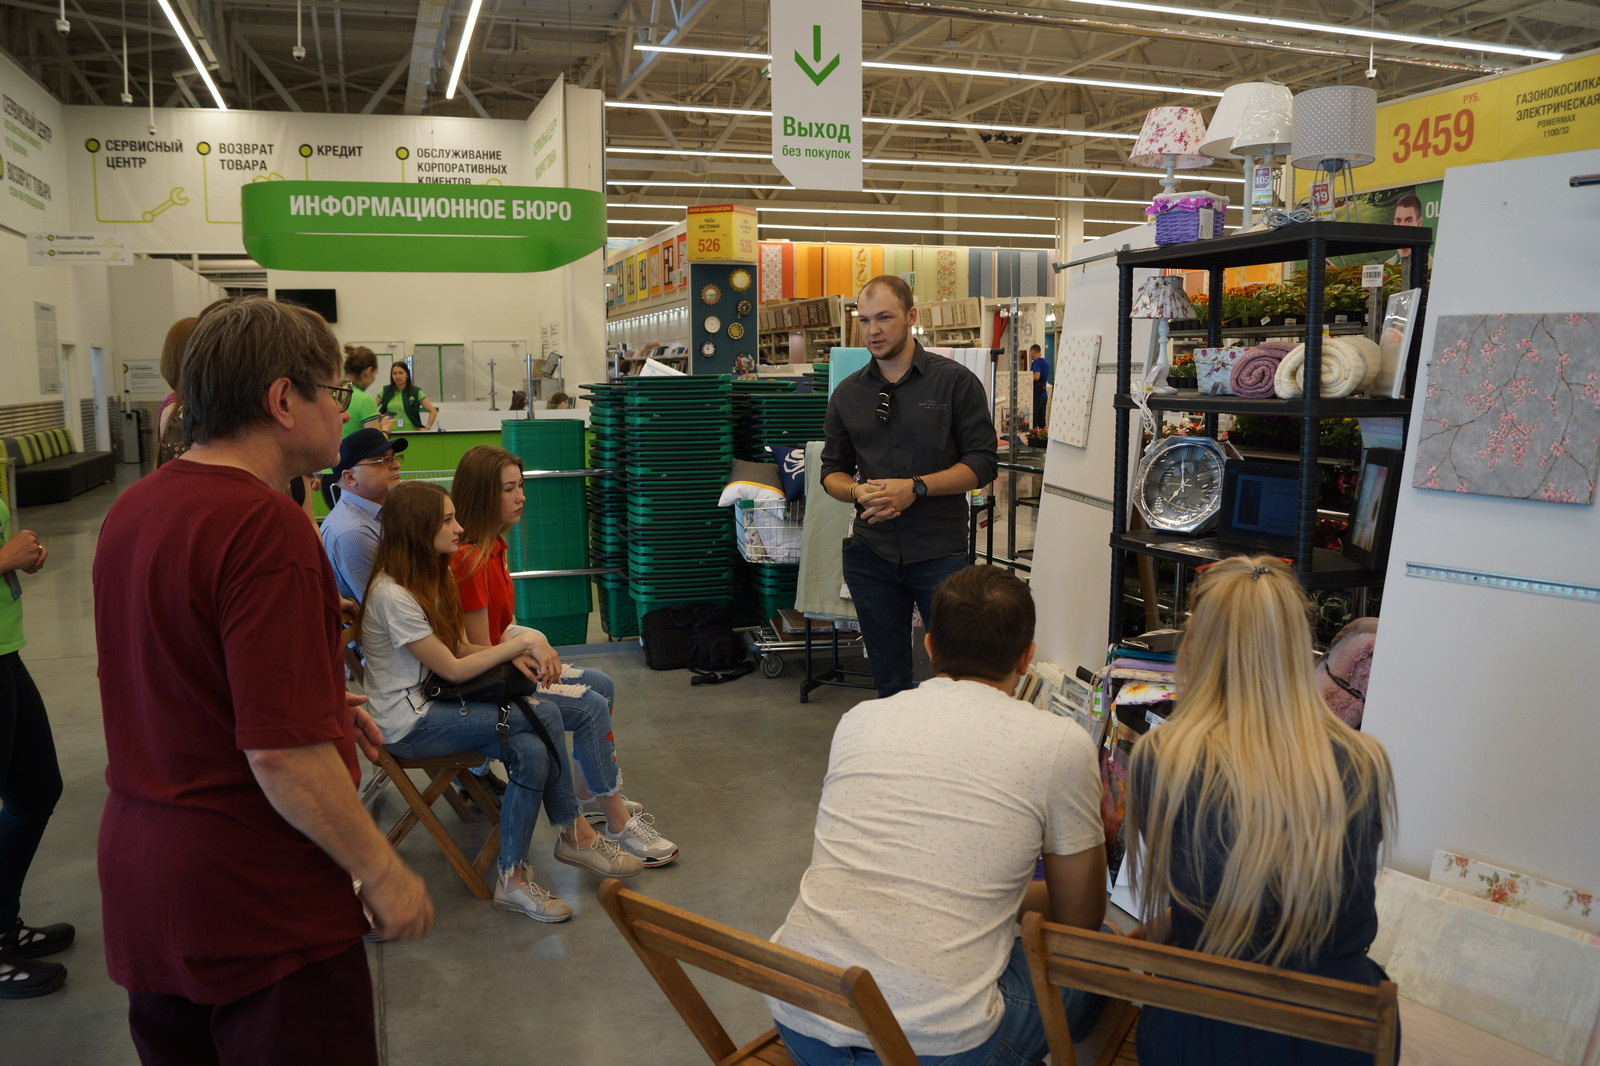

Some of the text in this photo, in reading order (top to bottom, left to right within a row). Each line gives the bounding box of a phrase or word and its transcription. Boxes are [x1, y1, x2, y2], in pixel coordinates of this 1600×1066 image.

[1515, 76, 1600, 106] ГАЗОНОКОСИЛКА
[1463, 92, 1481, 105] РУБ.
[1516, 93, 1600, 122] ЭЛЕКТРИЧЕСКАЯ
[1537, 113, 1576, 129] POWERMAX
[782, 115, 851, 143] Выход
[1392, 108, 1475, 164] 3459
[1543, 125, 1570, 138] 1100/32
[105, 138, 183, 153] СЕРВИСНЫЙ
[218, 142, 275, 156] ВОЗВРАТ
[316, 143, 363, 158] КРЕДИТ
[782, 145, 851, 160] без покупок
[416, 147, 502, 161] ОБСЛУЖИВАНИЕ
[106, 156, 147, 170] ЦЕНТР
[219, 159, 268, 171] ТОВАРА
[416, 161, 508, 175] КОРПОРАТИВНЫХ
[1256, 175, 1269, 184] 105
[1314, 191, 1328, 202] 19
[290, 195, 572, 221] ИНФОРМАЦИОННОЕ БЮРО
[698, 238, 720, 253] 526
[741, 240, 752, 254] 526
